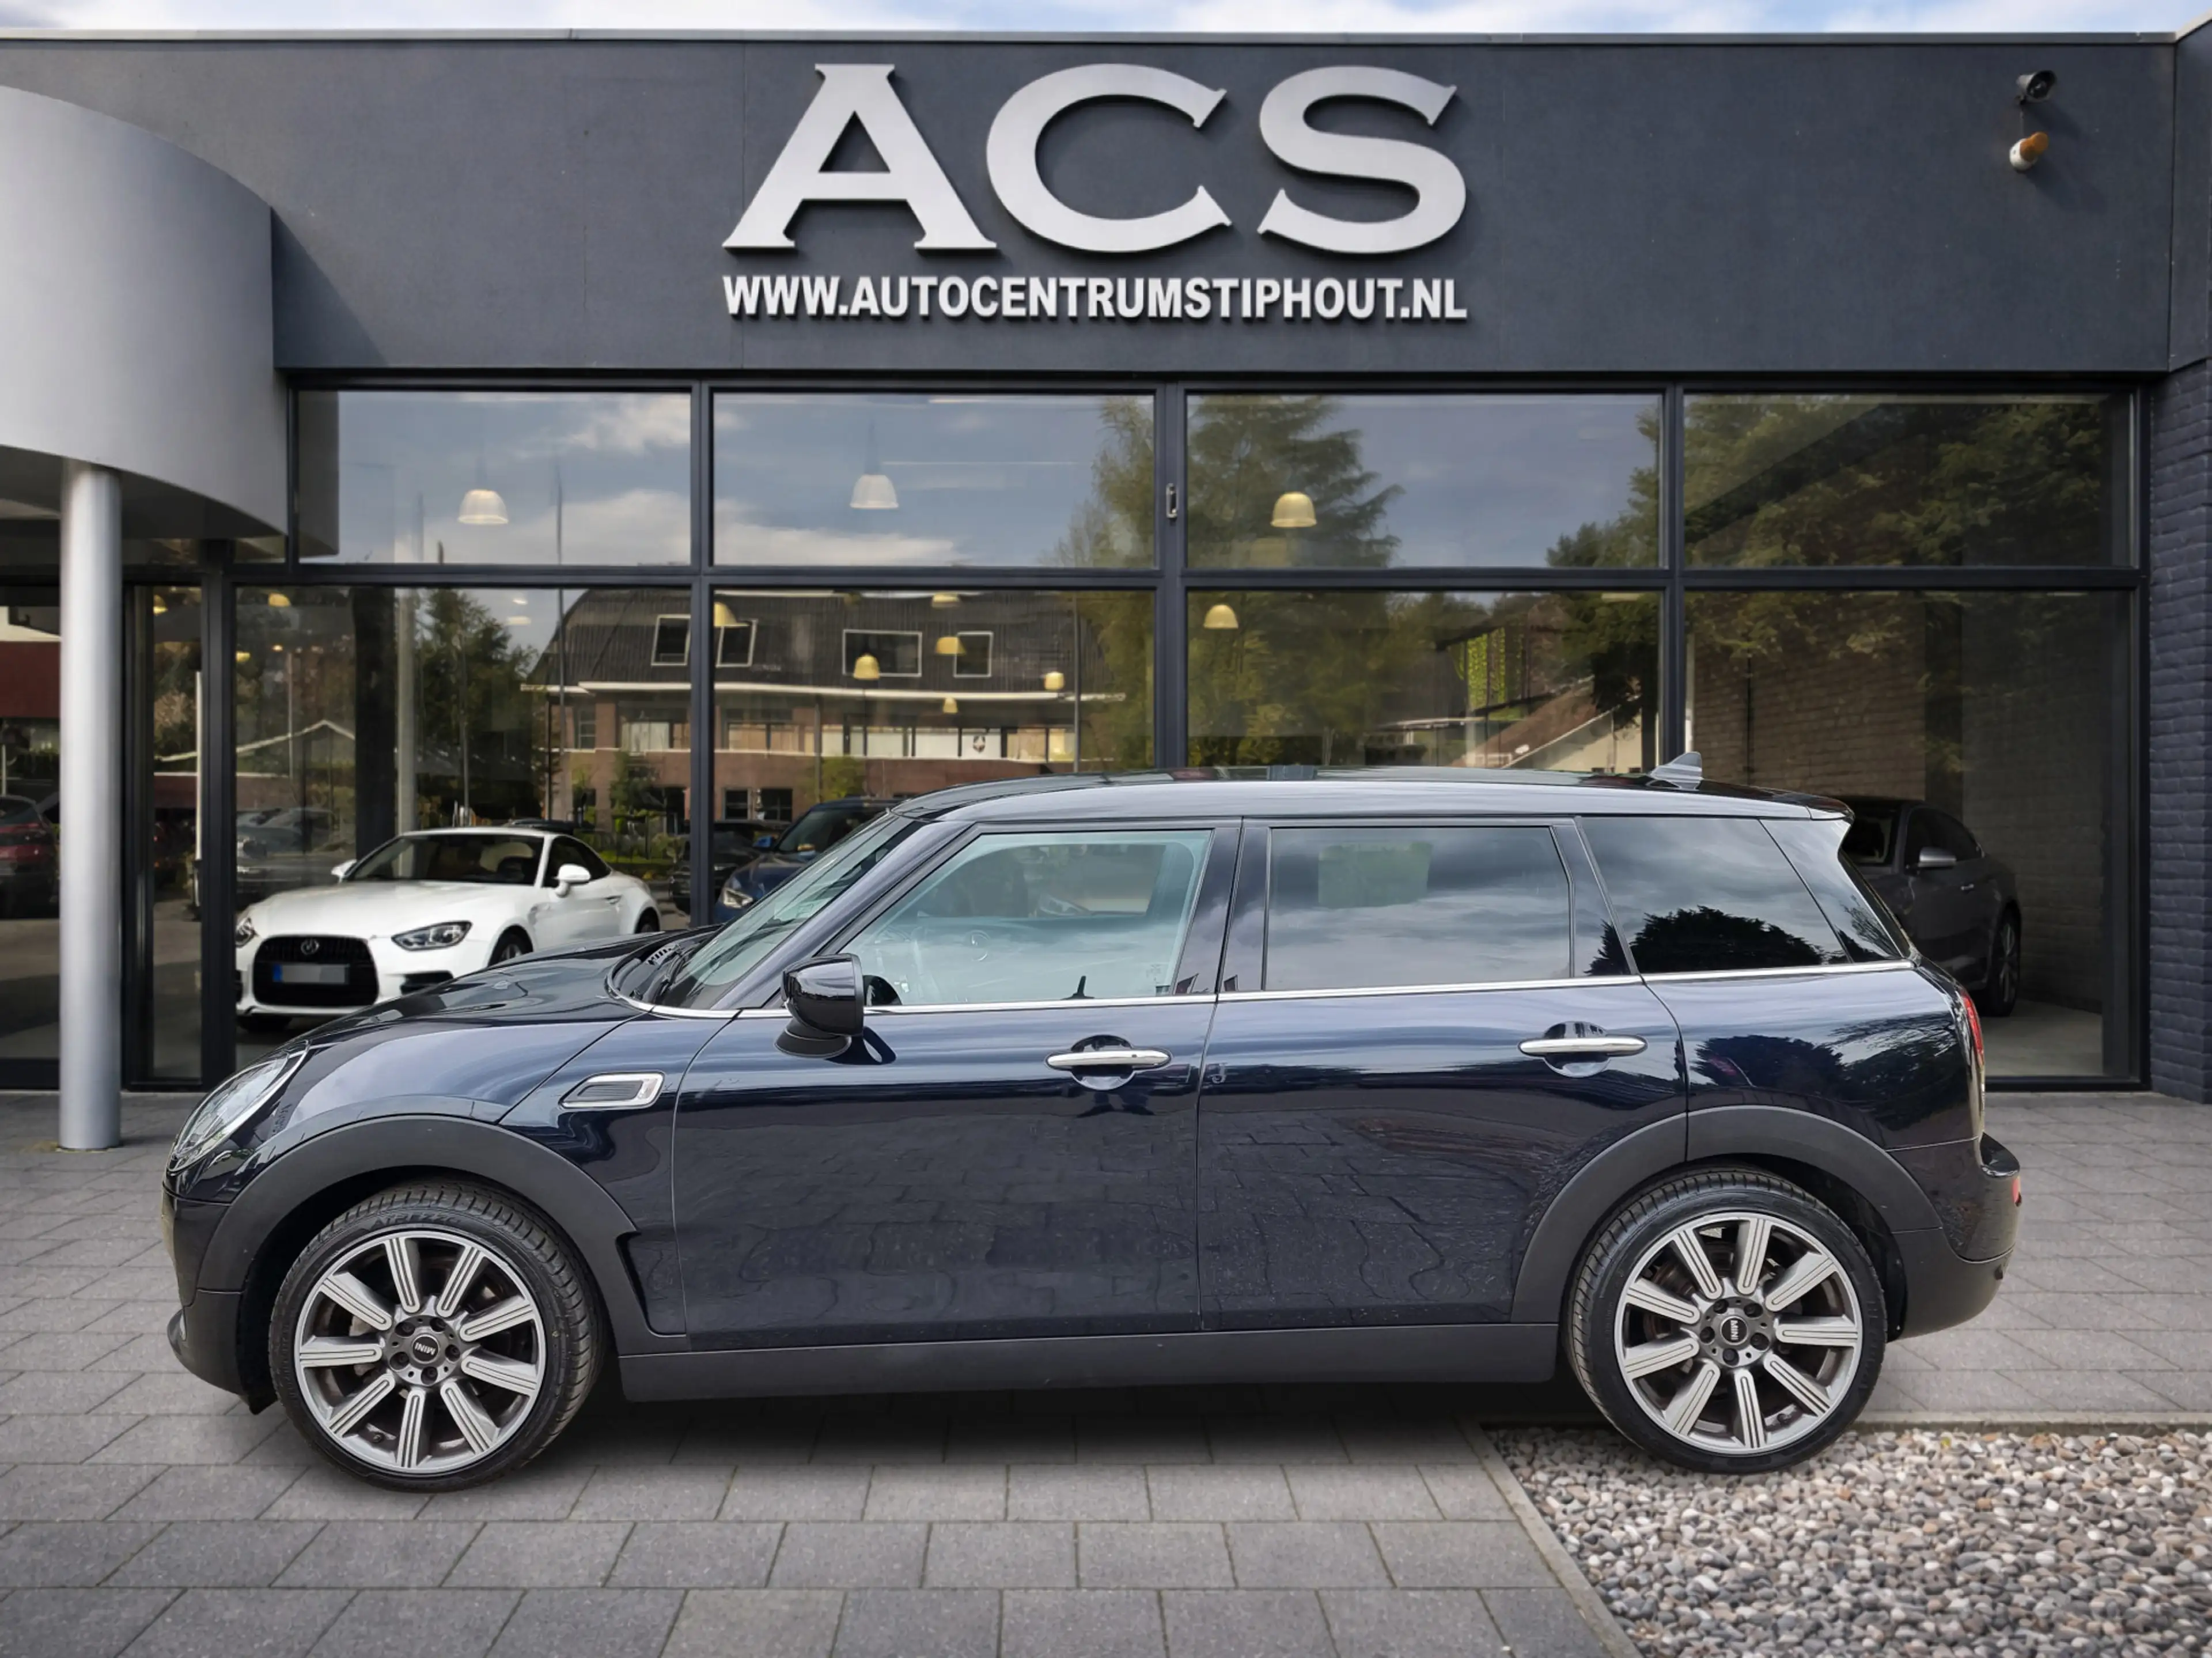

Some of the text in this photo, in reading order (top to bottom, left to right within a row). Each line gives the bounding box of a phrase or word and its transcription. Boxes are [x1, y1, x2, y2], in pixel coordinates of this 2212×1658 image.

[722, 63, 1467, 253] ACS
[723, 275, 1468, 320] WWW.AUTOCENTRUMSTIPHOUT.NL
[1730, 1319, 1739, 1341] MINI
[414, 1342, 437, 1356] MINI
